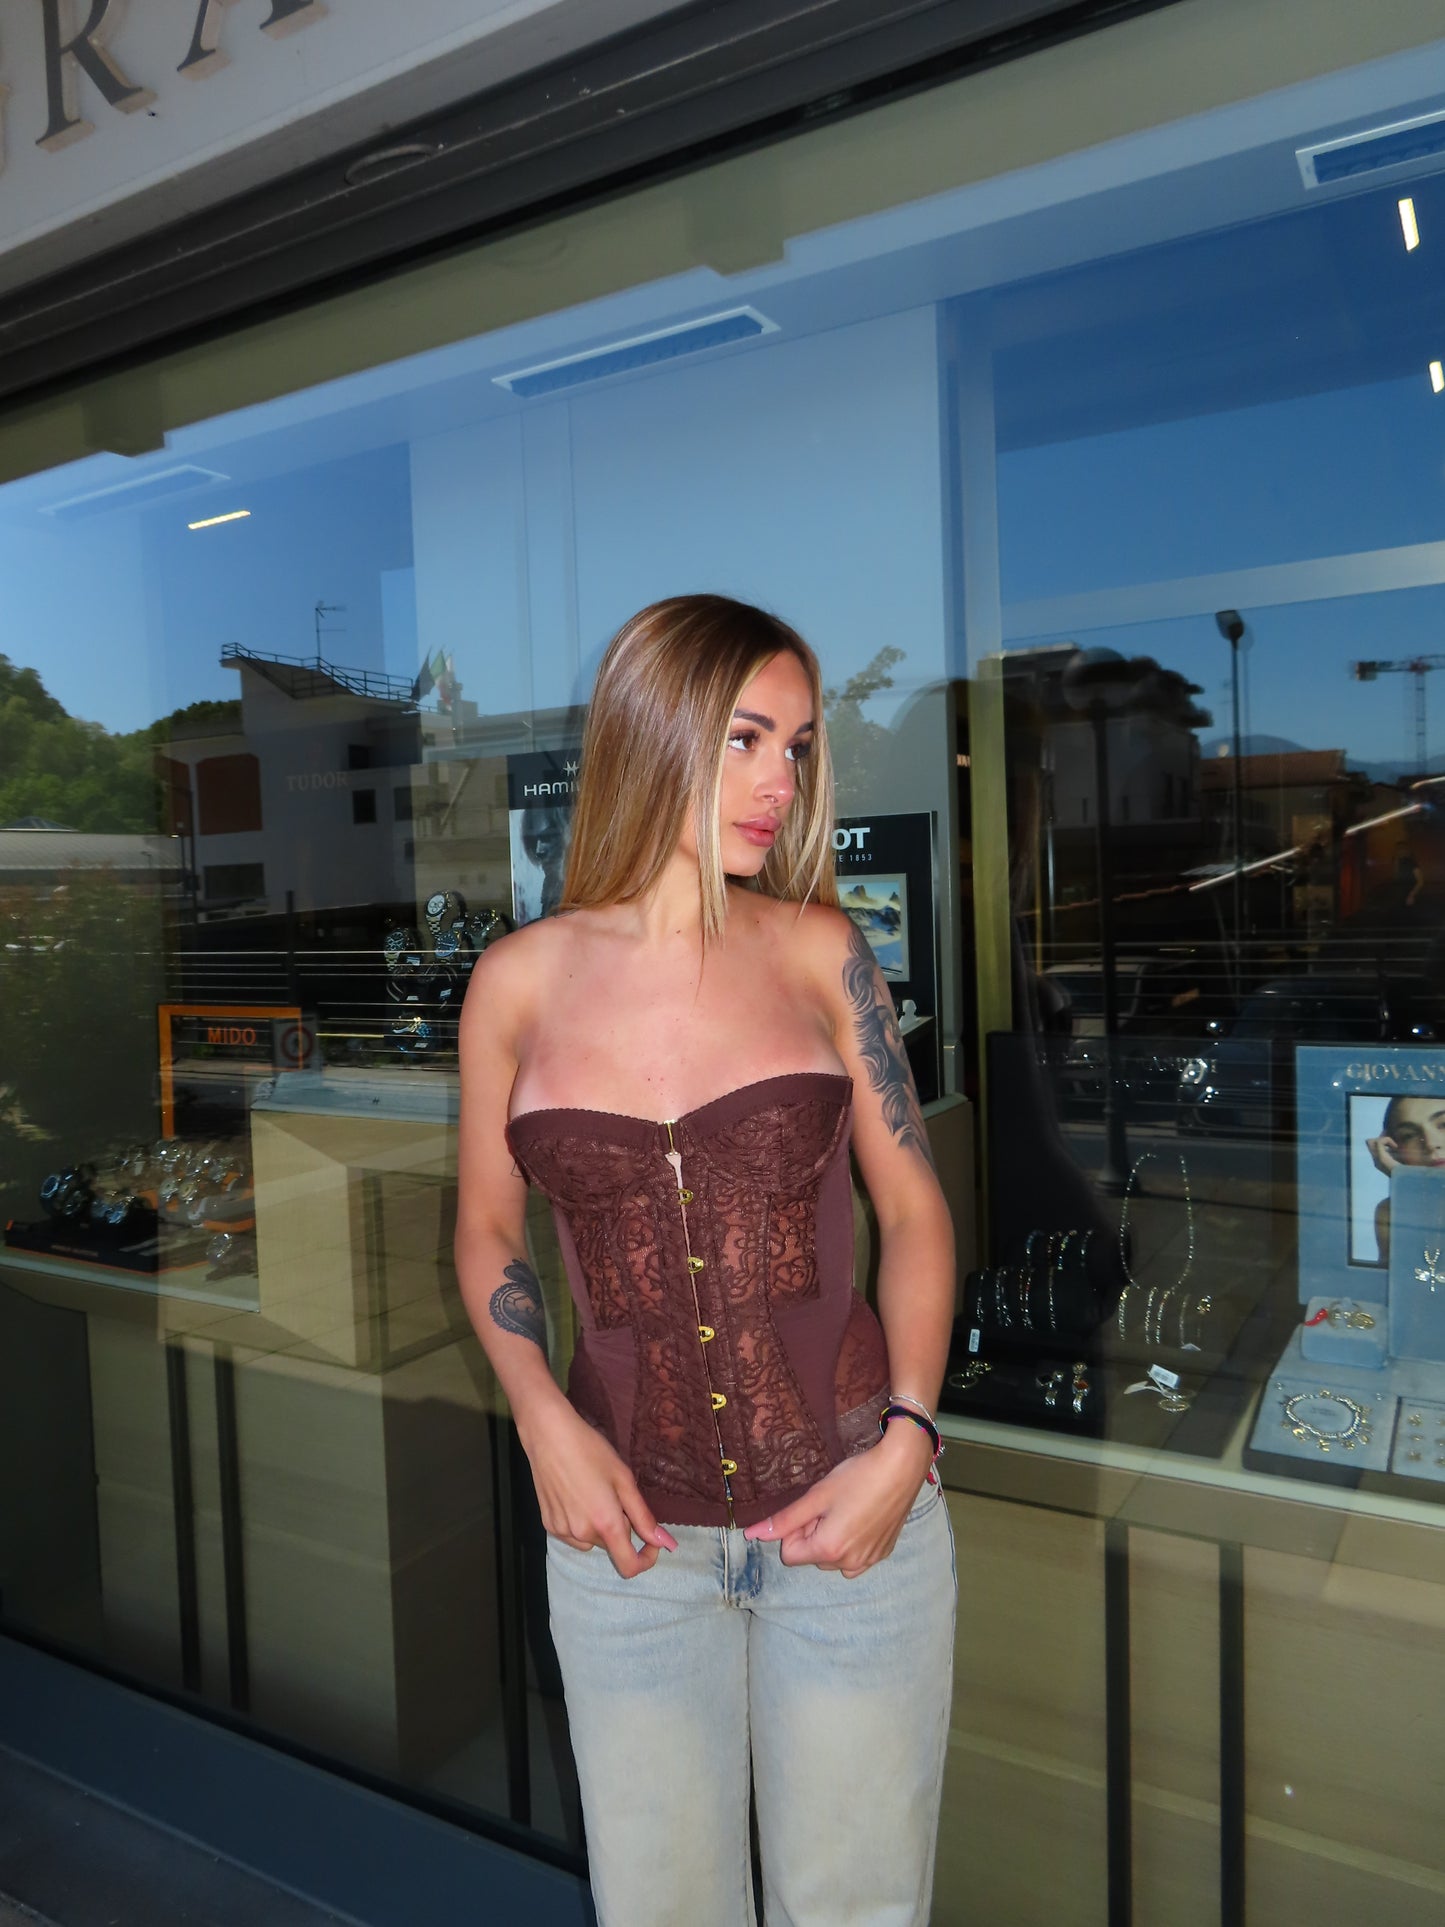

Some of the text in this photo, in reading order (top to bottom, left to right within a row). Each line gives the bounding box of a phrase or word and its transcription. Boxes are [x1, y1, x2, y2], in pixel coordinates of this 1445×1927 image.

[285, 770, 350, 792] TUDOR
[831, 827, 870, 850] OT
[850, 853, 872, 862] 1853
[207, 1027, 257, 1046] MIDO
